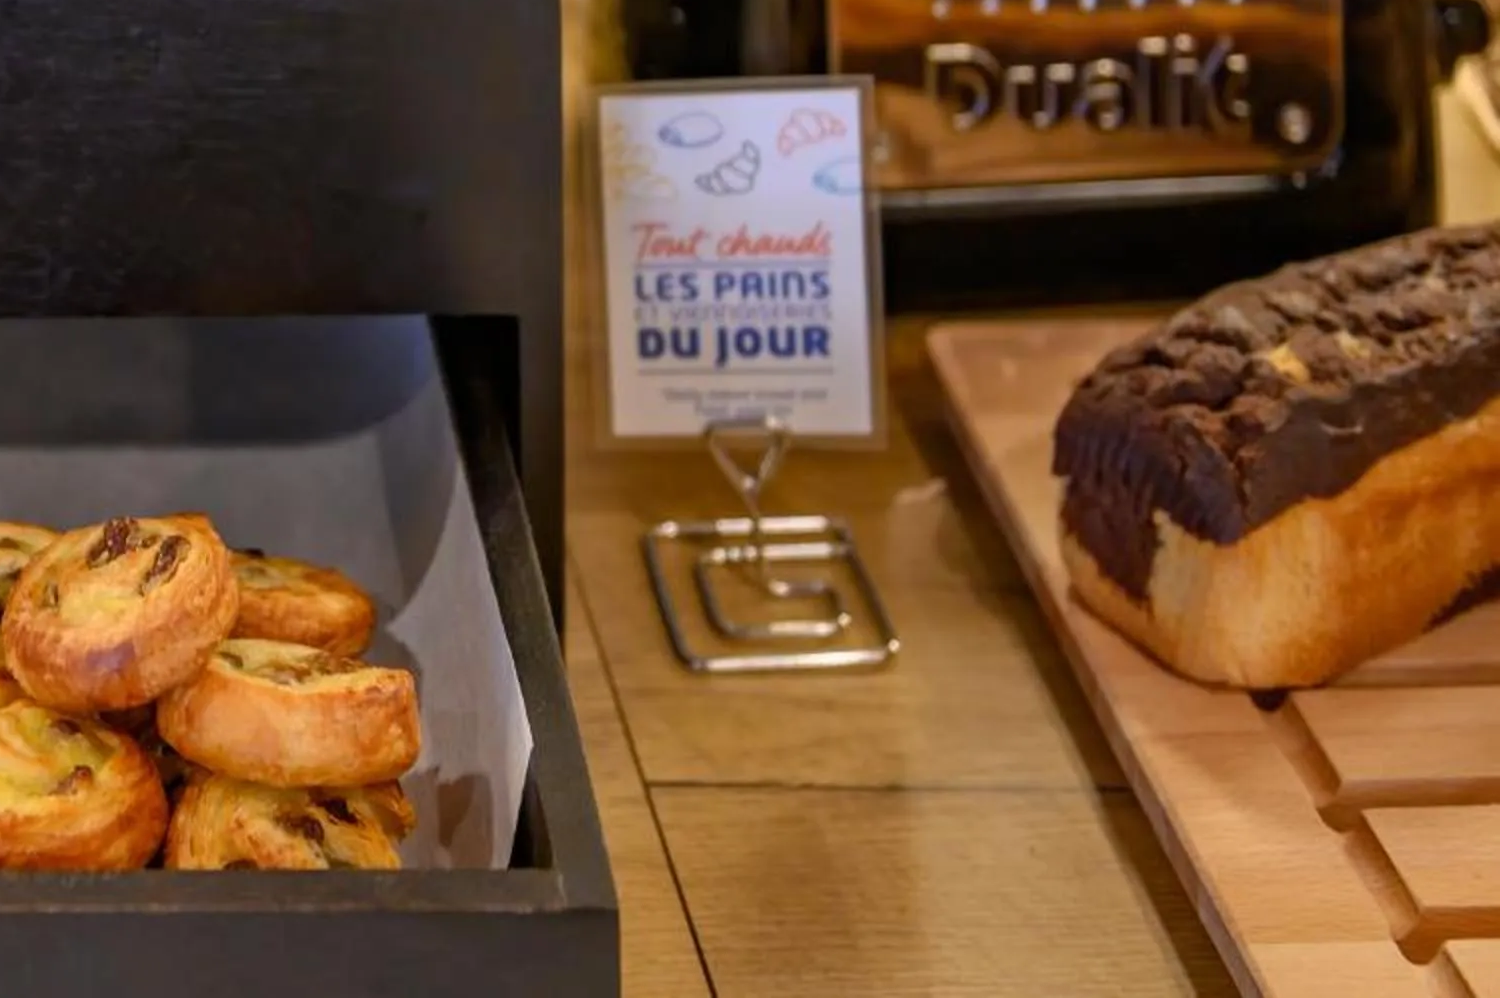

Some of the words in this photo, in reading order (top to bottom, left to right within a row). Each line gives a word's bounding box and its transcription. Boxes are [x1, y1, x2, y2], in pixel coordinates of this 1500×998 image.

[633, 220, 709, 259] Tout
[716, 218, 832, 257] chauds
[634, 272, 700, 302] LES
[714, 270, 831, 300] PAINS
[638, 327, 700, 359] DU
[714, 326, 831, 370] JOUR
